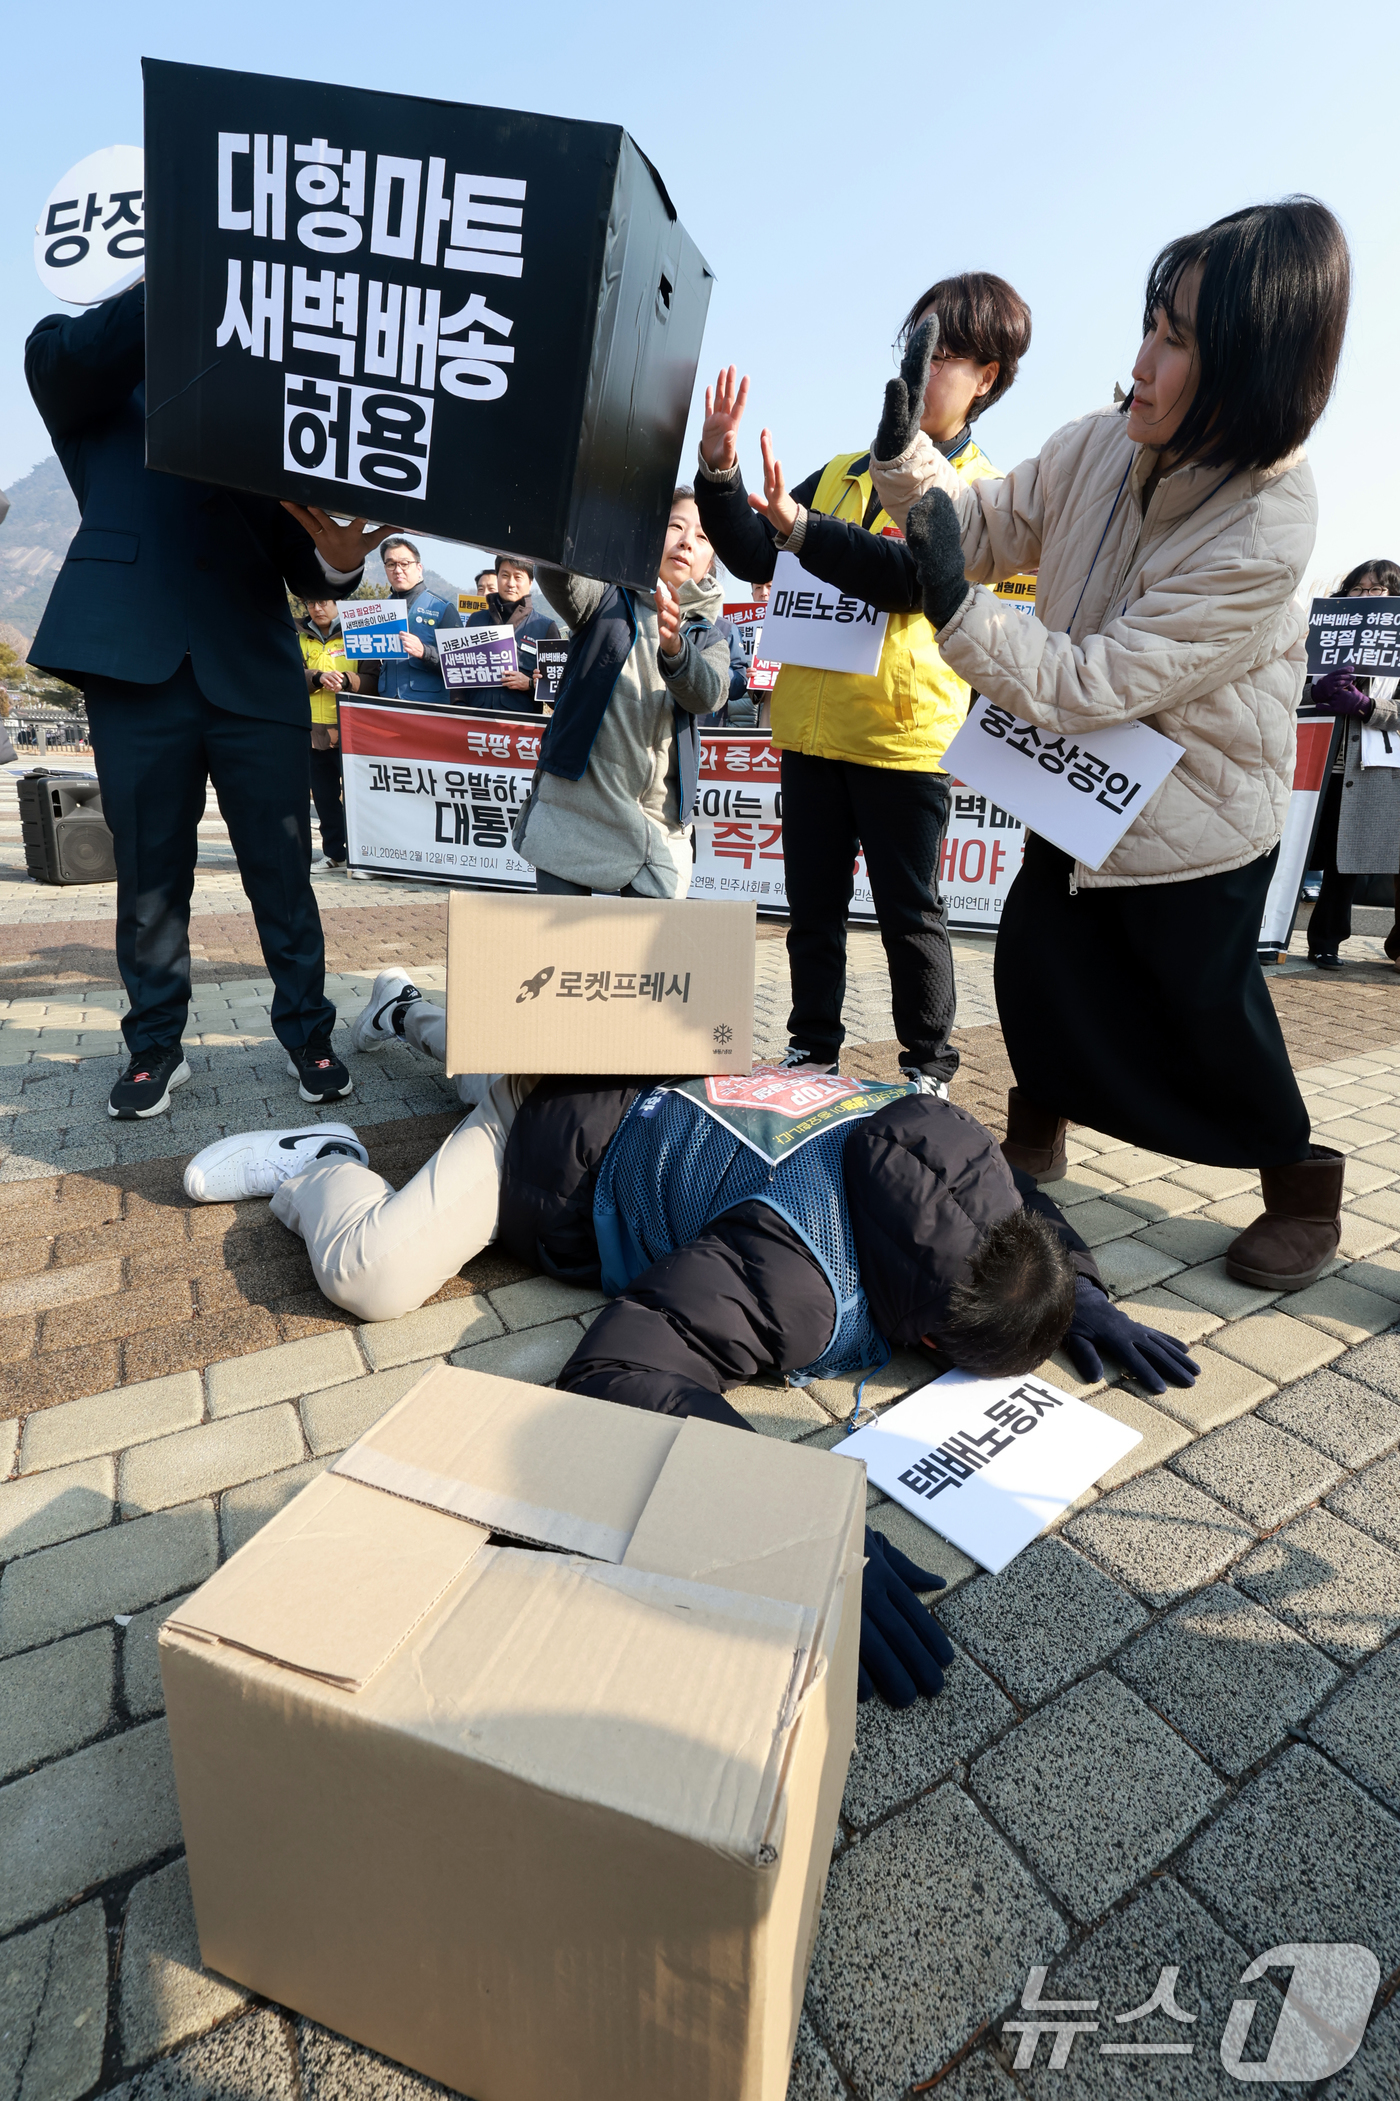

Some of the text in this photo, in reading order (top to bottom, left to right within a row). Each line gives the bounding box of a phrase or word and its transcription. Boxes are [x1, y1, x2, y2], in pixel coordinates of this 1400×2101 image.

[218, 132, 527, 278] 대형마트
[216, 258, 515, 401] 새벽배송
[286, 377, 429, 492] 허용
[342, 603, 382, 619] 지금 필요한건
[459, 600, 487, 610] 대형마트
[755, 606, 767, 619] 유
[346, 611, 397, 630] 새벽배송이 아니라
[1309, 612, 1364, 627] 새벽배송
[345, 633, 407, 653] 쿠팡규제
[442, 630, 500, 652] 과로사 부르는
[1320, 630, 1356, 647] 명절
[445, 649, 513, 666] 새벽배송 논의
[538, 652, 568, 663] 새벽배송
[1321, 649, 1340, 665] 더
[467, 731, 512, 759] 쿠팡
[515, 736, 542, 761] 잡
[724, 746, 782, 772] 중소
[980, 703, 1142, 815] 중소상공인
[368, 763, 437, 796] 과로사
[361, 845, 408, 861] 일시_2026년
[409, 850, 423, 863] 2월
[425, 852, 458, 865] 12일(목)
[460, 855, 477, 868] 오전
[480, 857, 499, 869] 10시
[720, 878, 771, 894] 민주사회를
[774, 882, 787, 895] 위
[555, 970, 692, 1004] 로켓프레시
[790, 1079, 850, 1106] STOP
[830, 1096, 869, 1115] 생명이
[772, 1110, 834, 1146] 중요합니다.
[896, 1382, 1064, 1501] 택배노동자
